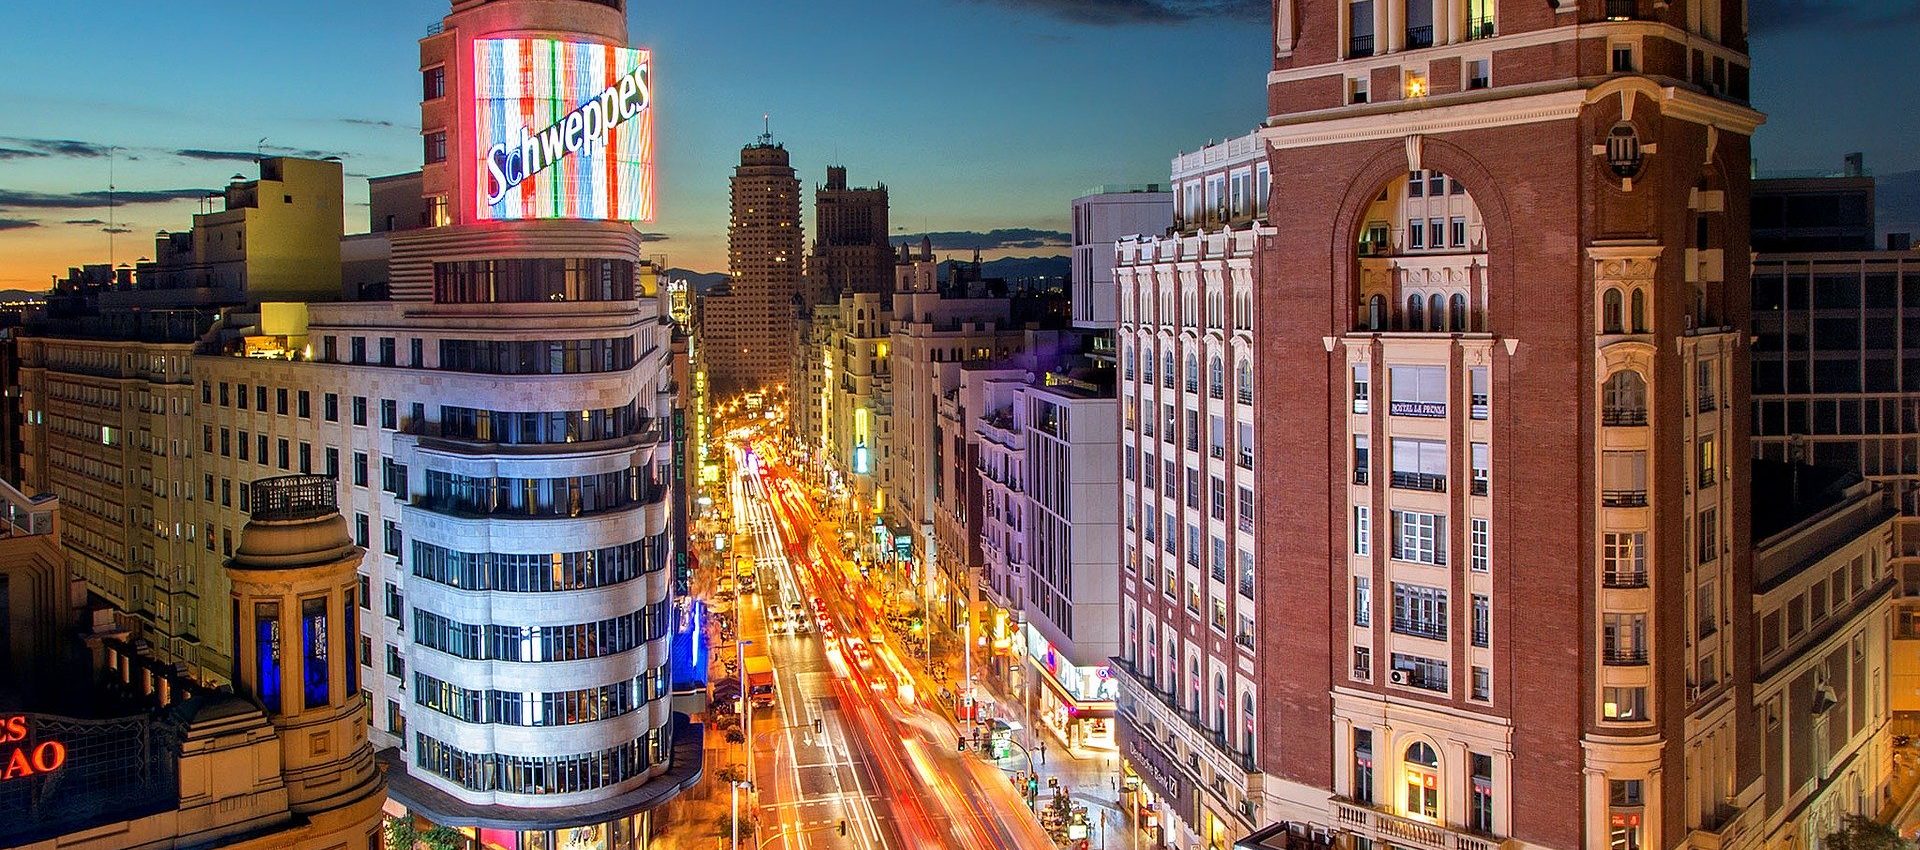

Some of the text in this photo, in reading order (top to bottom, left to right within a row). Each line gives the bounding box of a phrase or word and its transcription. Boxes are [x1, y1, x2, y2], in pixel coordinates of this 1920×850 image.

[487, 61, 650, 206] Schweppes
[696, 371, 704, 413] HOTEL
[675, 414, 686, 591] HOTEL REX
[0, 741, 66, 780] AO
